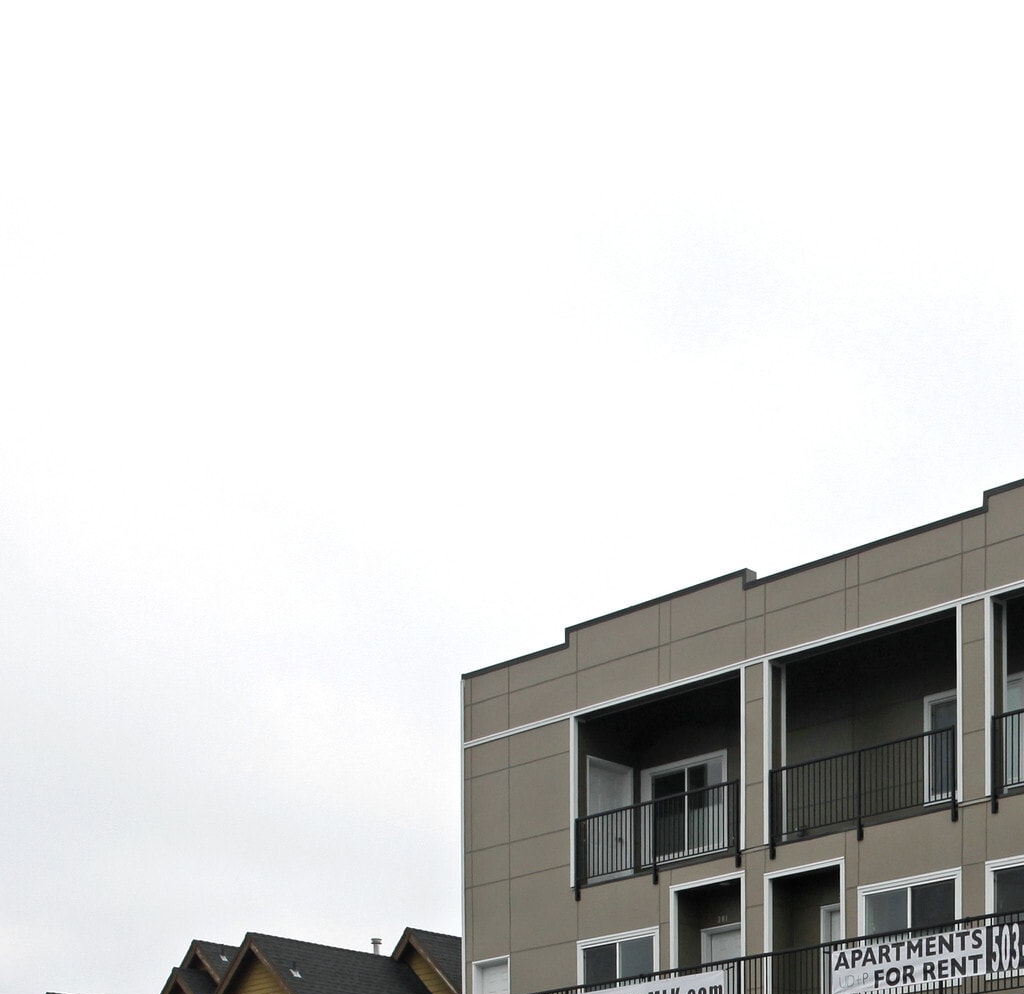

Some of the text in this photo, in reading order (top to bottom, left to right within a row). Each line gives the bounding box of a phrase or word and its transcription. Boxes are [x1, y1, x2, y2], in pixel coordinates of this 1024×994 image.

[834, 928, 983, 972] APARTMENTS
[874, 954, 983, 989] FOR RENT
